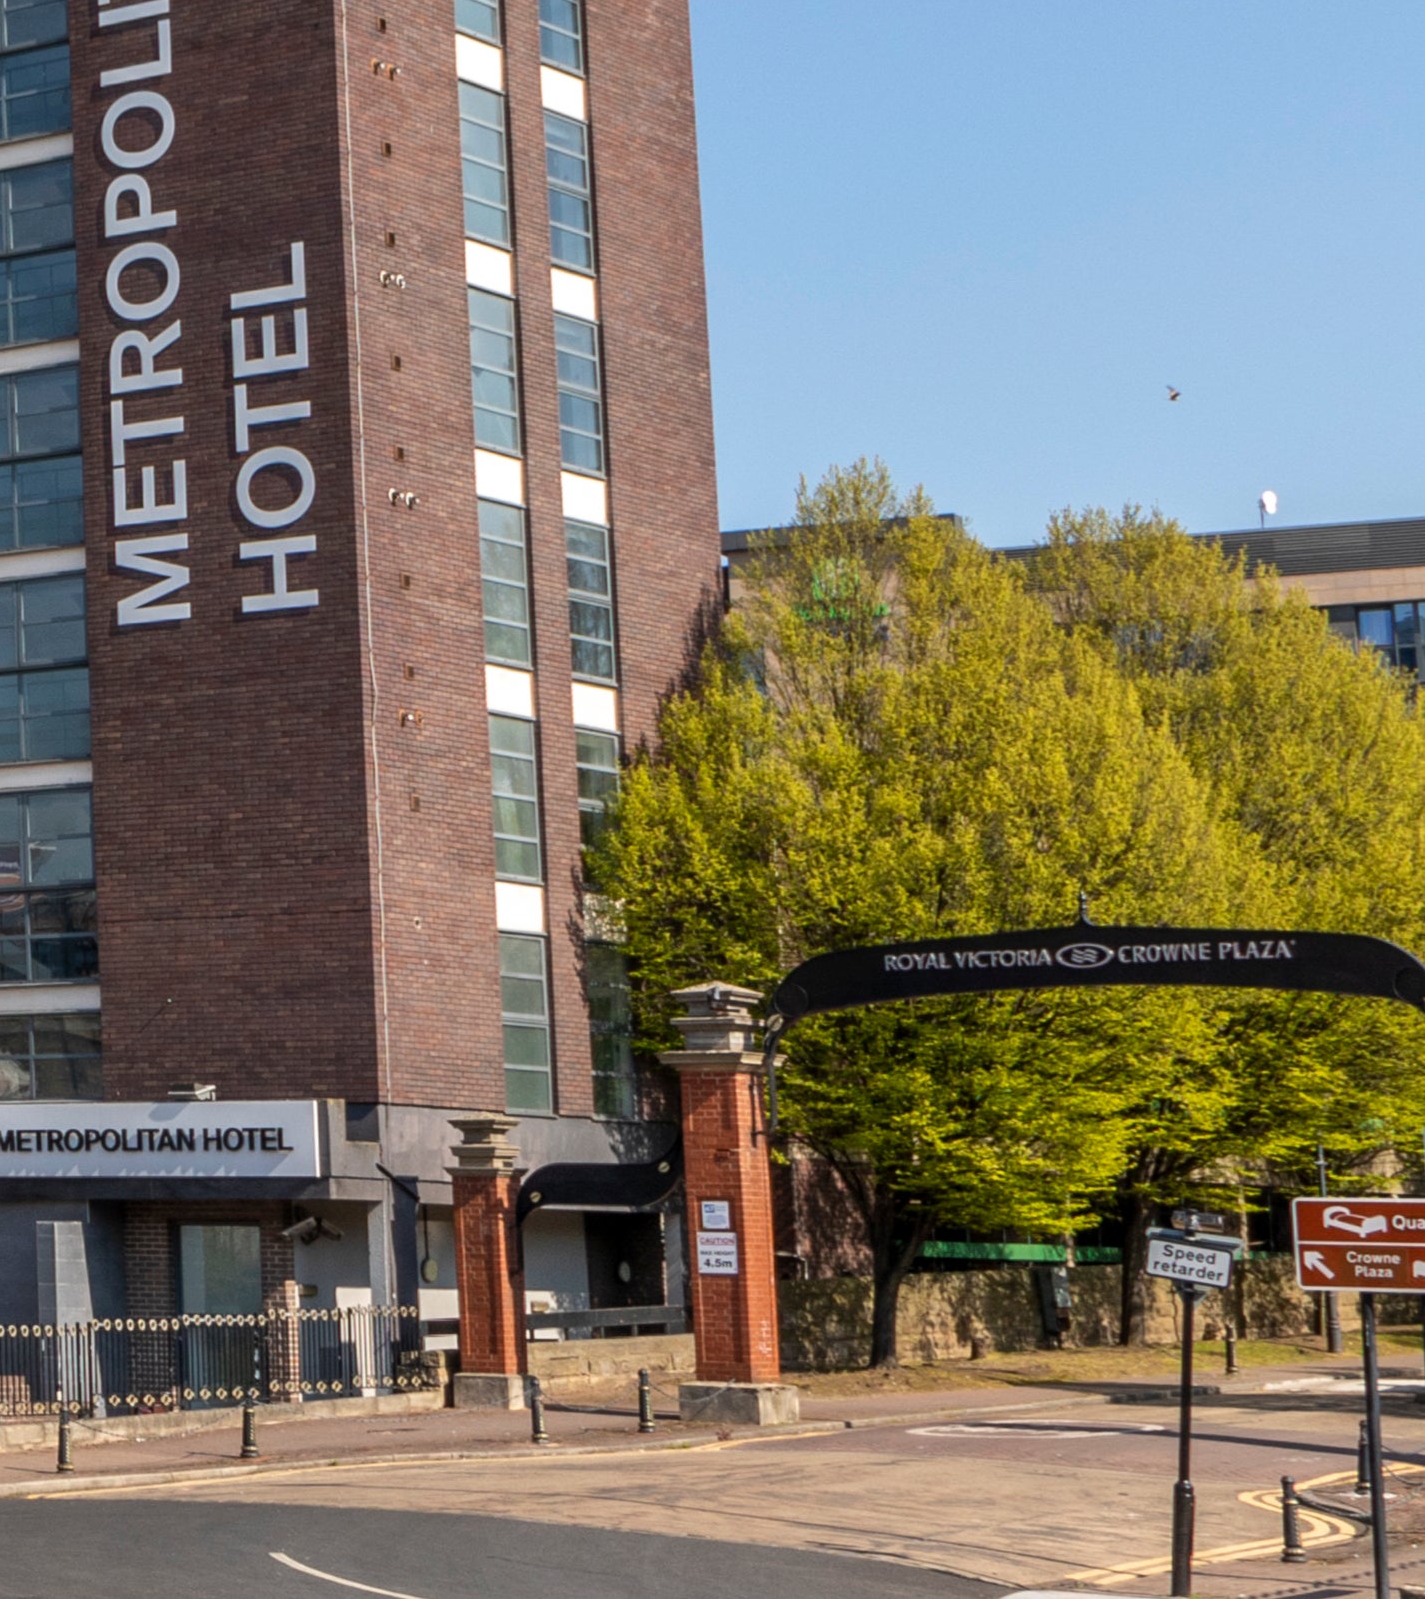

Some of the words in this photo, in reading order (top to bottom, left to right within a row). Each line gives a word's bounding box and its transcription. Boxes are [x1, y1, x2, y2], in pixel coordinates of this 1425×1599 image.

[230, 241, 320, 613] HOTEL
[884, 952, 952, 972] ROYAL
[955, 948, 1052, 968] VICTORIA
[1118, 942, 1212, 963] CROWNE
[1218, 939, 1292, 960] PLAZA
[202, 1127, 294, 1151] HOTEL
[703, 1258, 733, 1268] 4.5m
[1162, 1244, 1217, 1265] Speed
[1346, 1251, 1401, 1264] Crowne
[1153, 1260, 1224, 1282] retarder
[1355, 1265, 1394, 1278] Plaza
